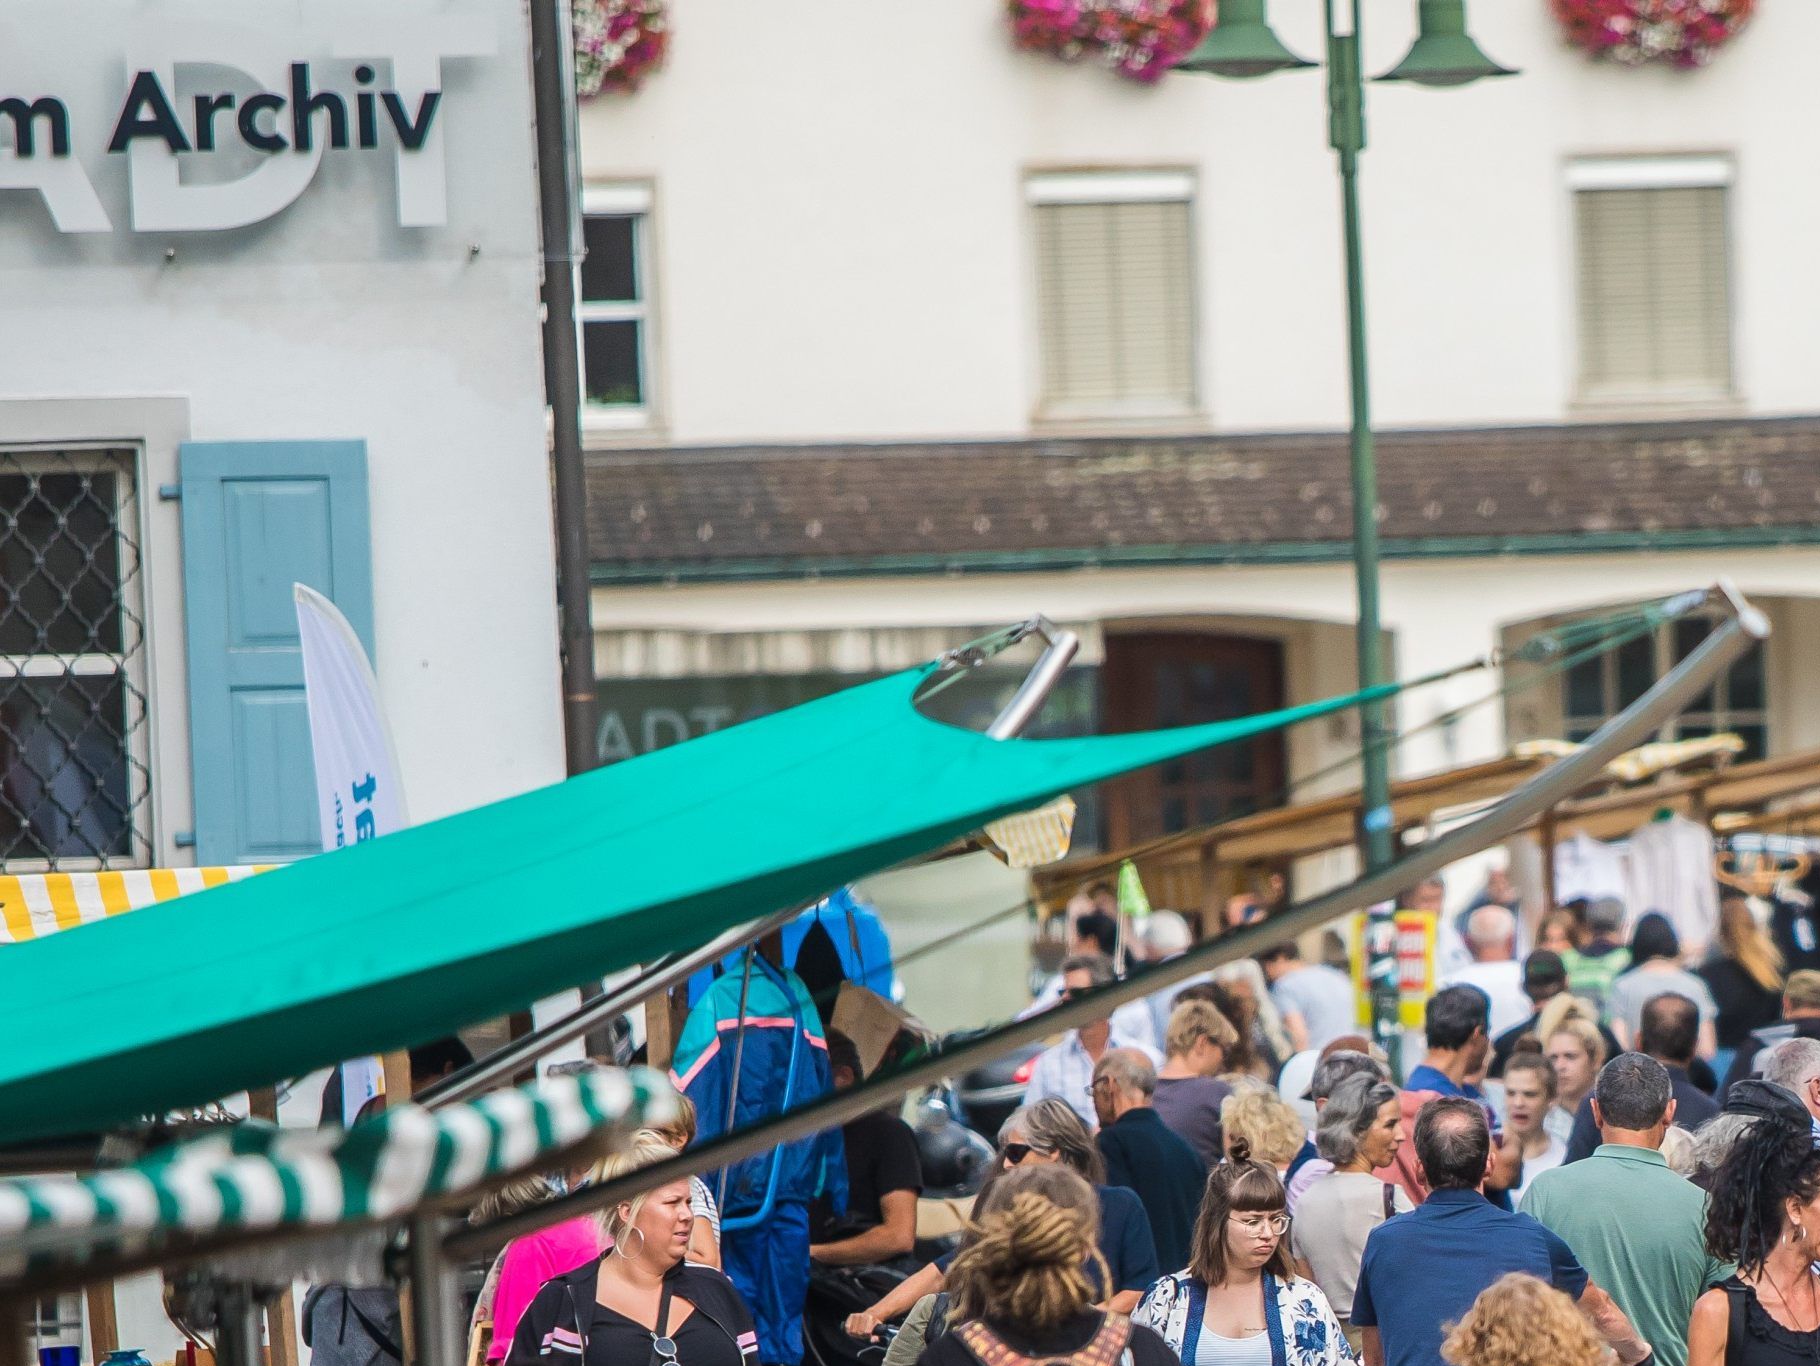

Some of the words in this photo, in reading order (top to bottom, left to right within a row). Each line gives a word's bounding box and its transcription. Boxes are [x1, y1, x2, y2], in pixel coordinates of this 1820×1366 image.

[0, 95, 71, 156] m
[107, 60, 443, 154] Archiv
[596, 706, 734, 760] ADT
